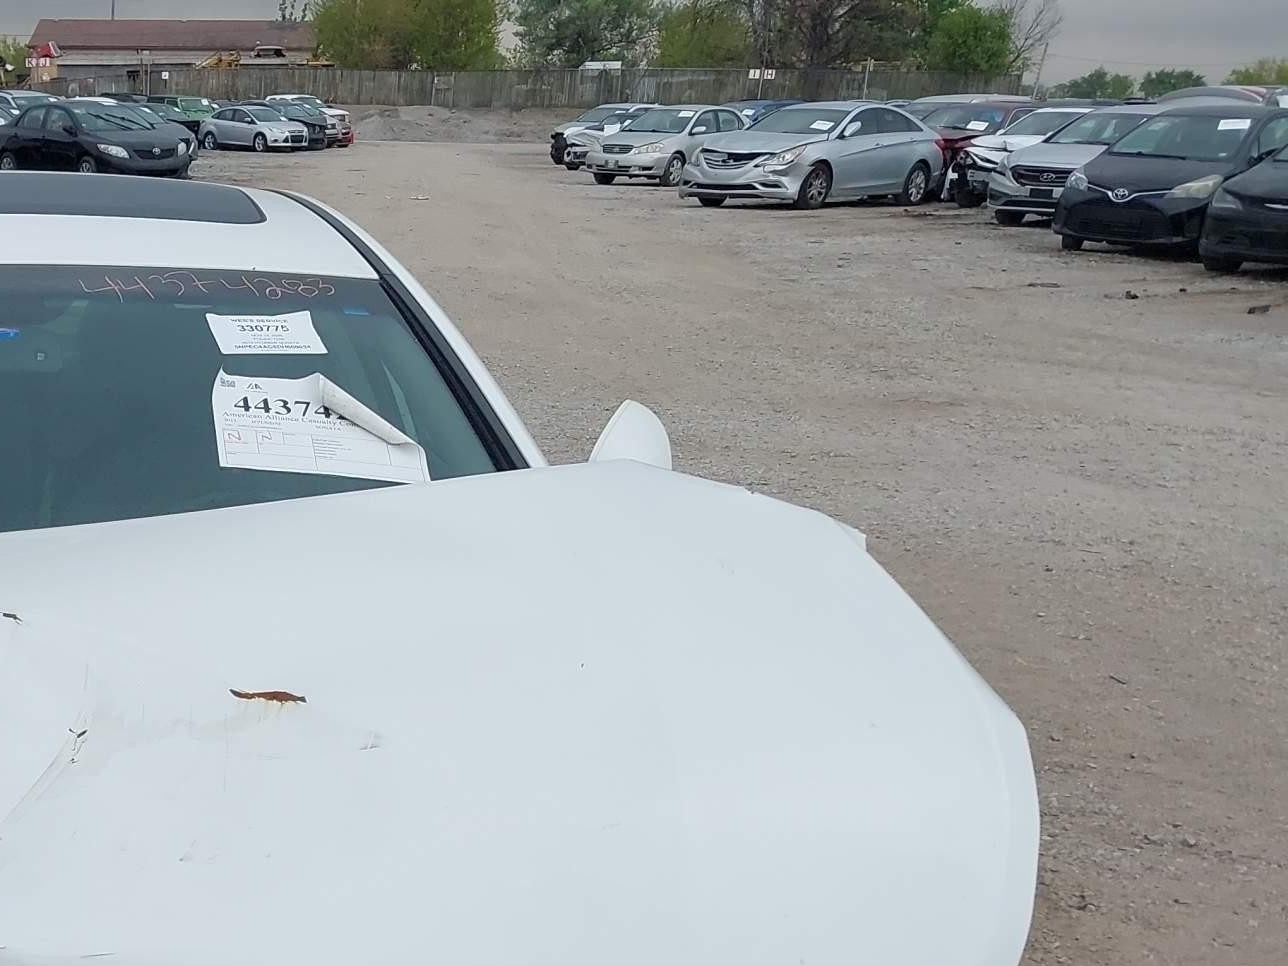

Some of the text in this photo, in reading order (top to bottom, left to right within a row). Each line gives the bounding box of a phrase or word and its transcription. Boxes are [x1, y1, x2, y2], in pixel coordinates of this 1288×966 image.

[78, 270, 335, 304] 44374283
[236, 324, 290, 333] 330775
[222, 411, 263, 420] American
[233, 396, 349, 420] 44374
